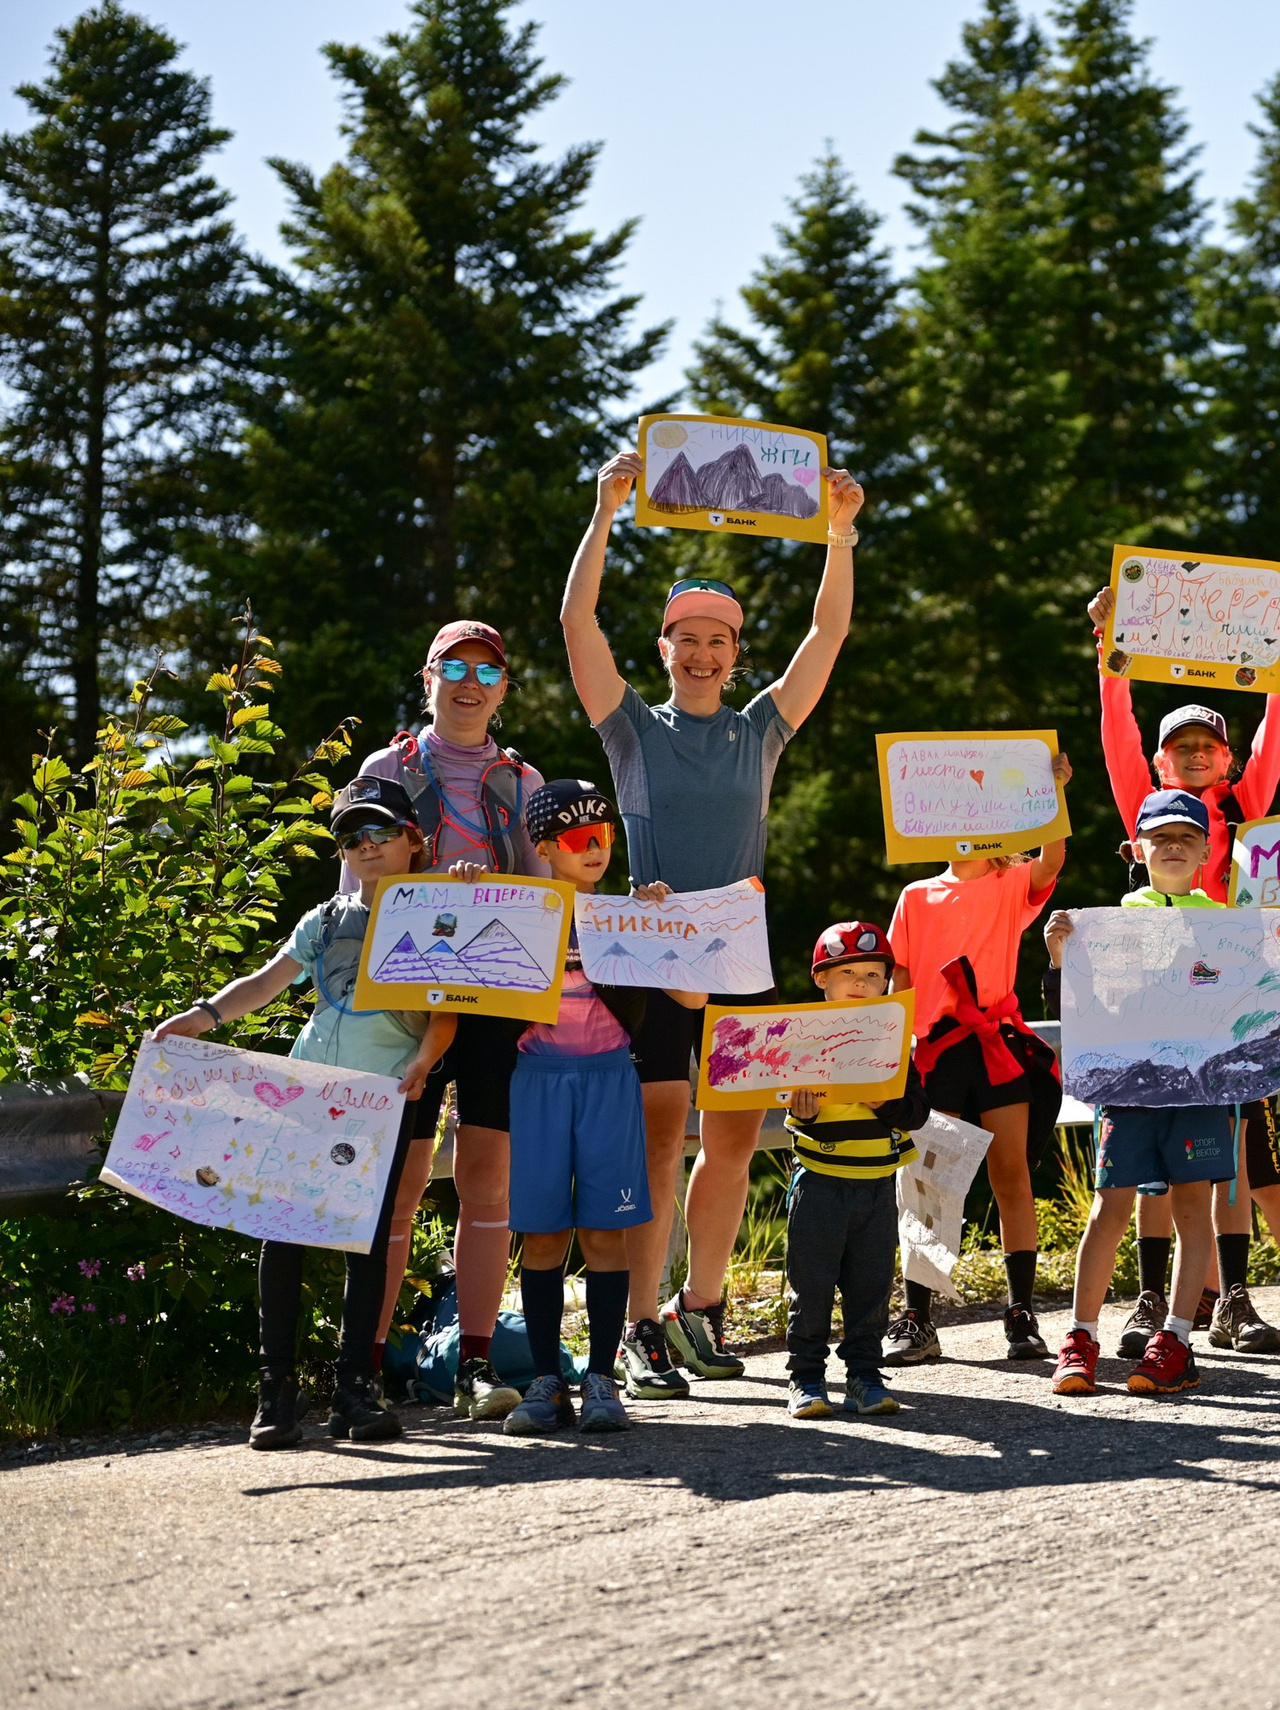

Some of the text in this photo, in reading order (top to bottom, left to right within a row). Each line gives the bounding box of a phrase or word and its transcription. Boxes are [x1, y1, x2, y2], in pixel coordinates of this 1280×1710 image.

[711, 424, 788, 448] НИКИТА
[760, 446, 811, 467] ЖГИ
[726, 517, 757, 527] БАНК
[1187, 669, 1217, 679] БАНК
[557, 798, 608, 825] DIIKE
[973, 841, 1003, 851] БАНК
[393, 884, 464, 906] МАМА
[593, 913, 699, 940] НИКИТА
[445, 994, 479, 1004] БАНК
[1194, 1137, 1217, 1148] СПОРТ
[1195, 1147, 1222, 1158] ВЕКТОР
